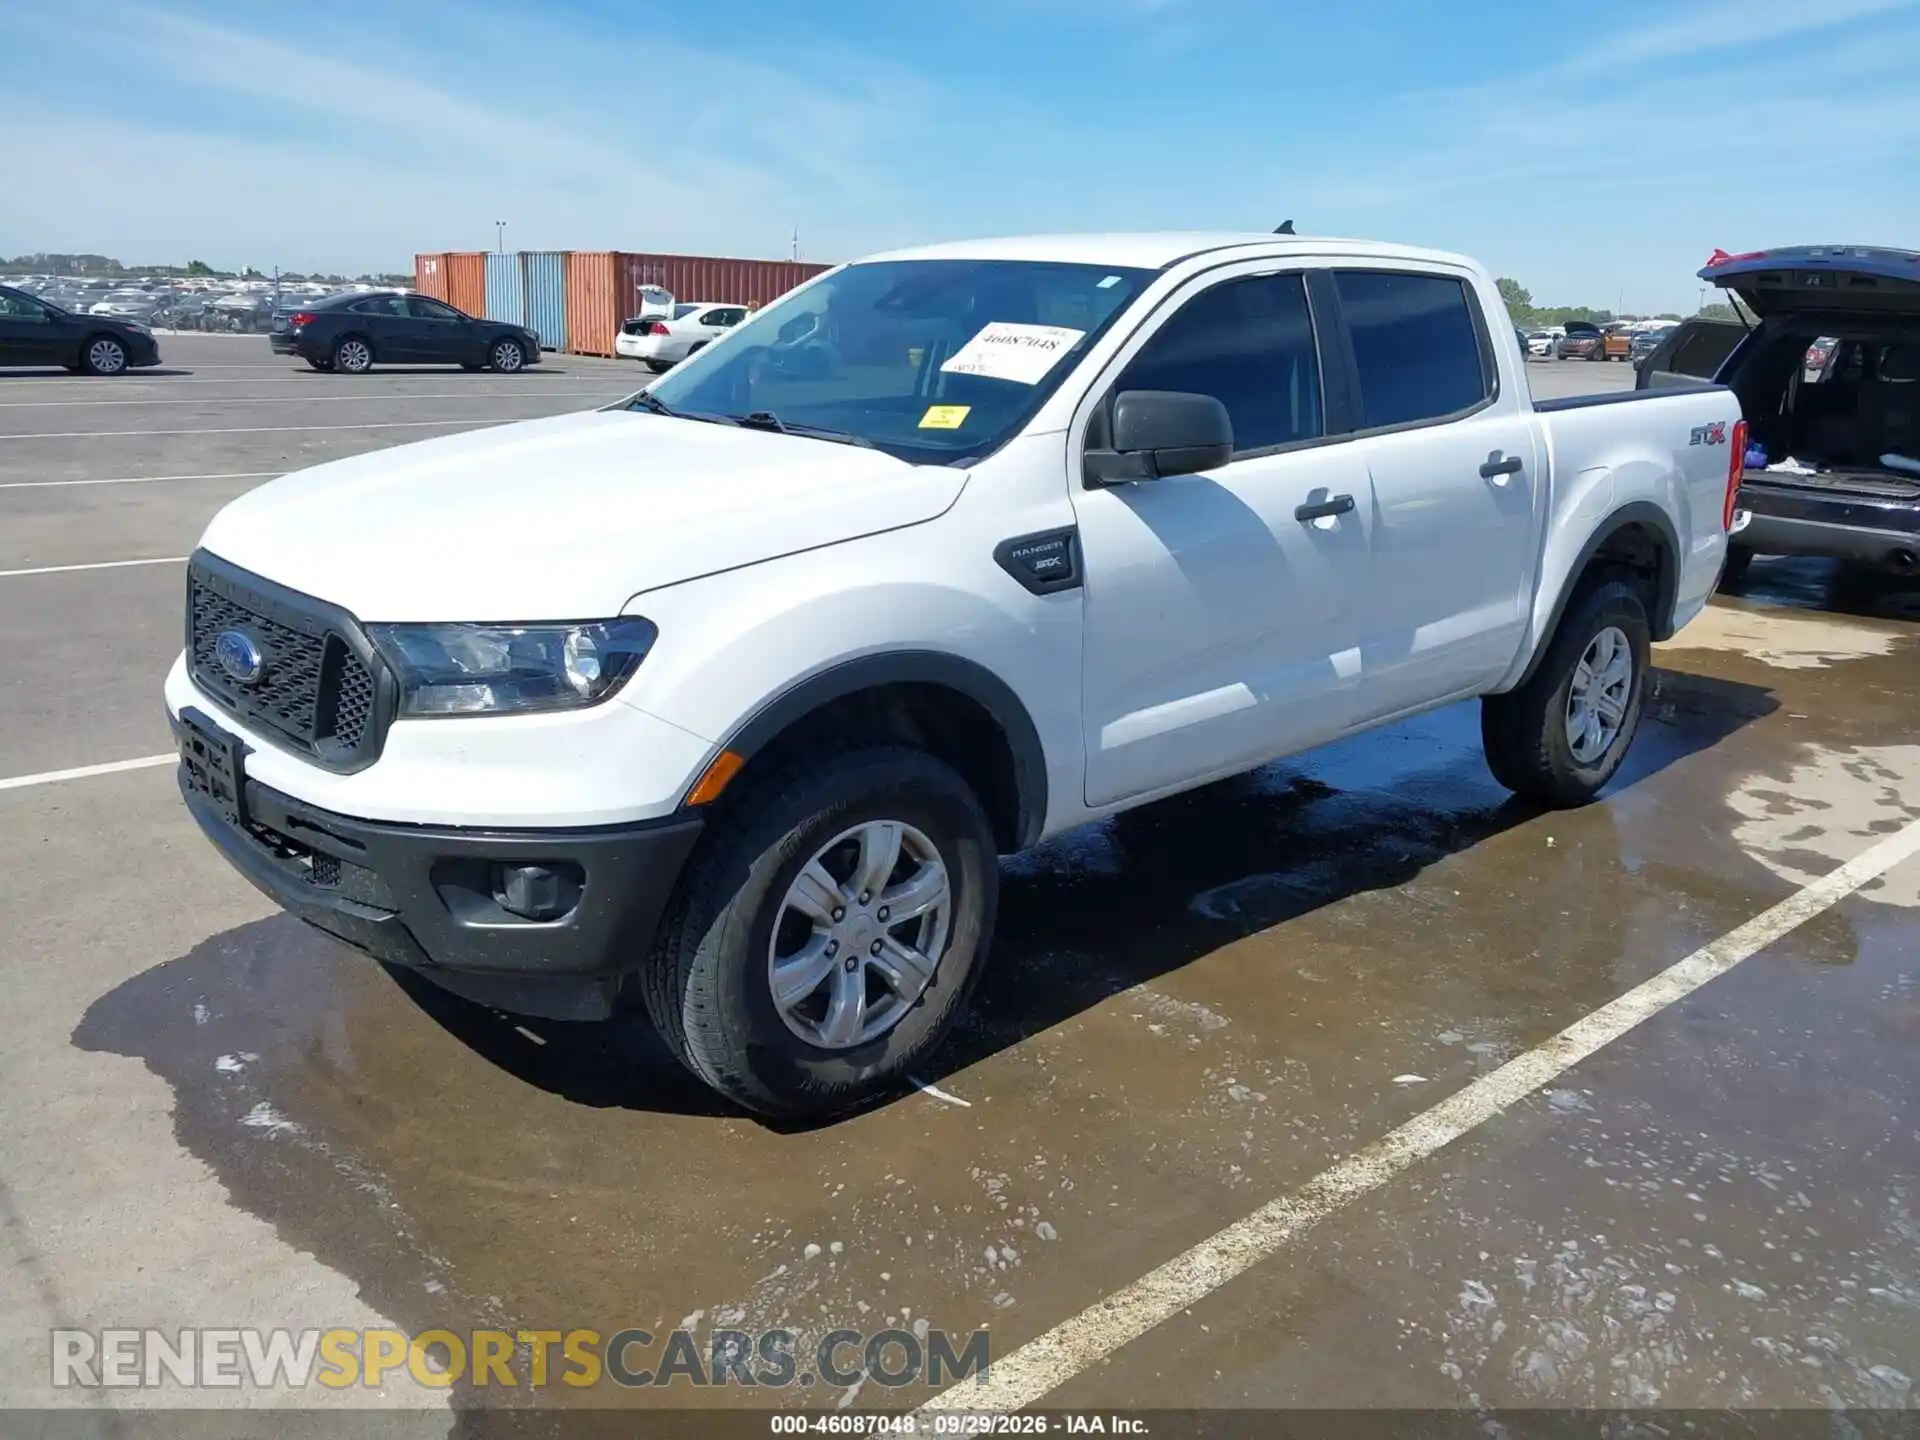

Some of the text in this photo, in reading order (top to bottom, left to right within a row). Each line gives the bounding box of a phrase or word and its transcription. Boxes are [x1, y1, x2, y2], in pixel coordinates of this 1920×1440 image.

[983, 334, 1060, 351] 46087048
[1689, 420, 1727, 446] STX
[1012, 541, 1064, 558] RANGER
[1034, 557, 1061, 570] STX
